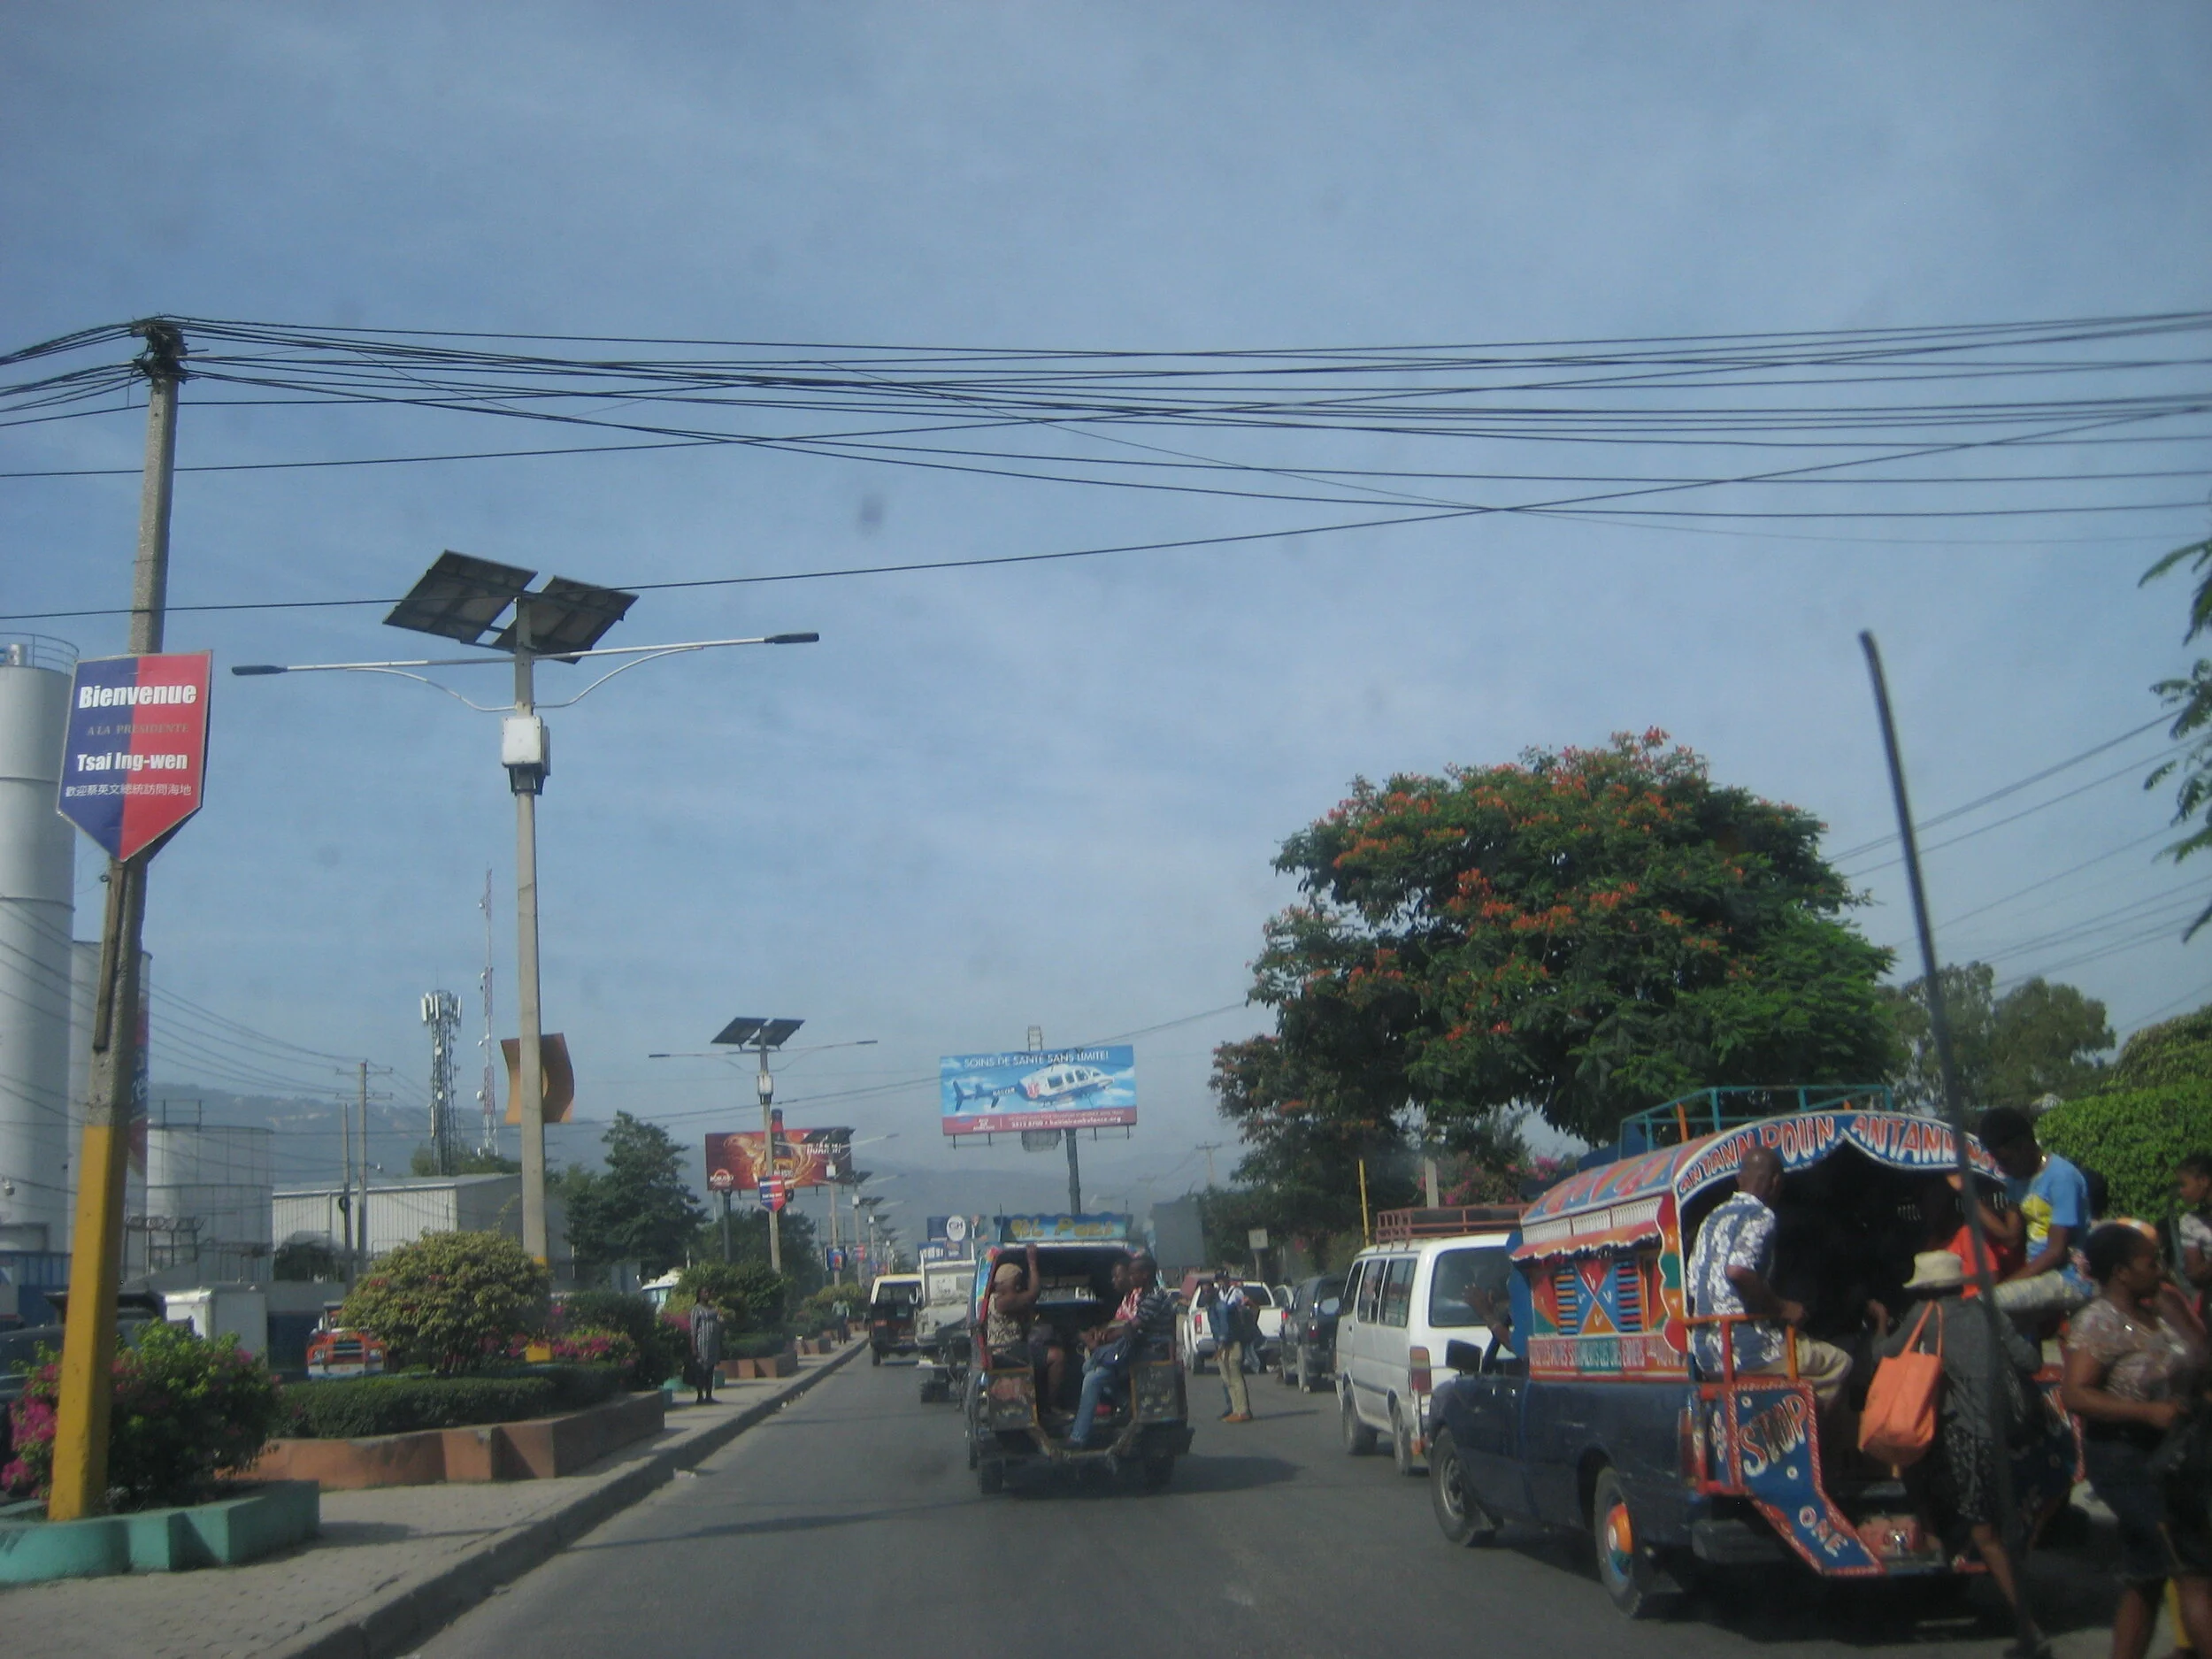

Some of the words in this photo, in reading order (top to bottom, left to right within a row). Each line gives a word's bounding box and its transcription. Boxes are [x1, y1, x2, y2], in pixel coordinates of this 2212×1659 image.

[78, 684, 197, 709] Bienvenue
[77, 753, 111, 772] Tsai
[115, 751, 188, 772] Ing-wen
